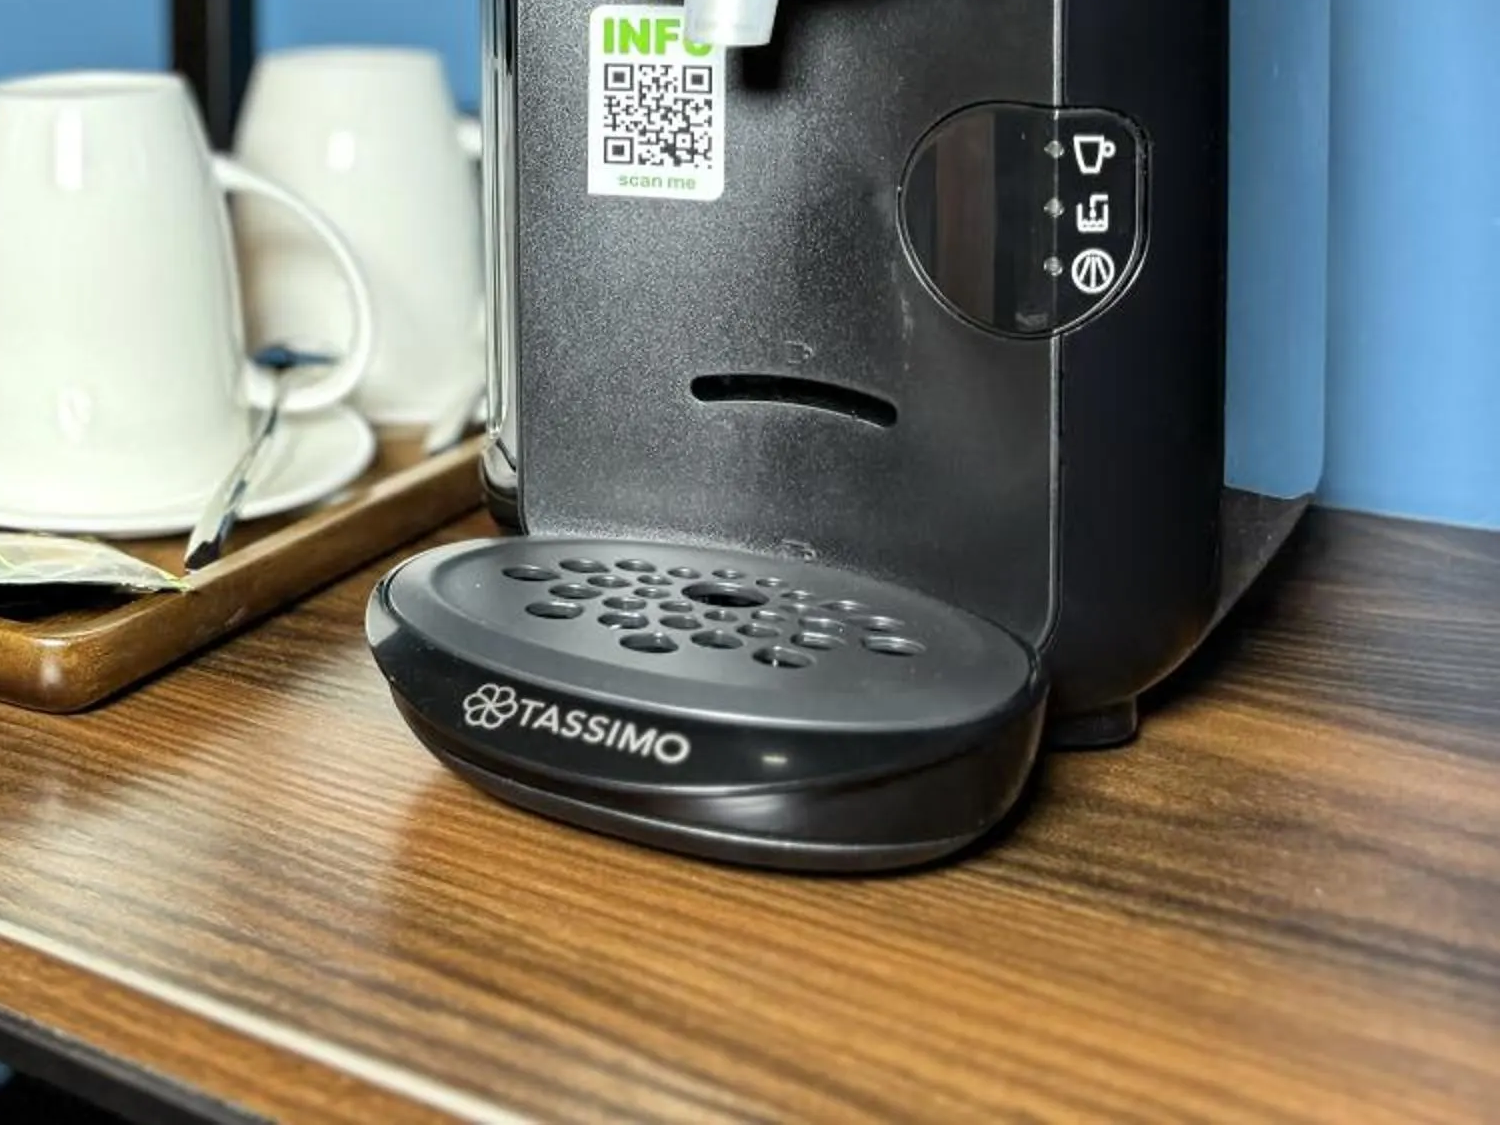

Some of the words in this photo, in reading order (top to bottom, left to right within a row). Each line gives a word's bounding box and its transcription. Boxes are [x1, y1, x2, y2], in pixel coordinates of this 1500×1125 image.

[618, 175, 662, 189] scan
[667, 177, 697, 191] me
[518, 697, 691, 764] TASSIMO
